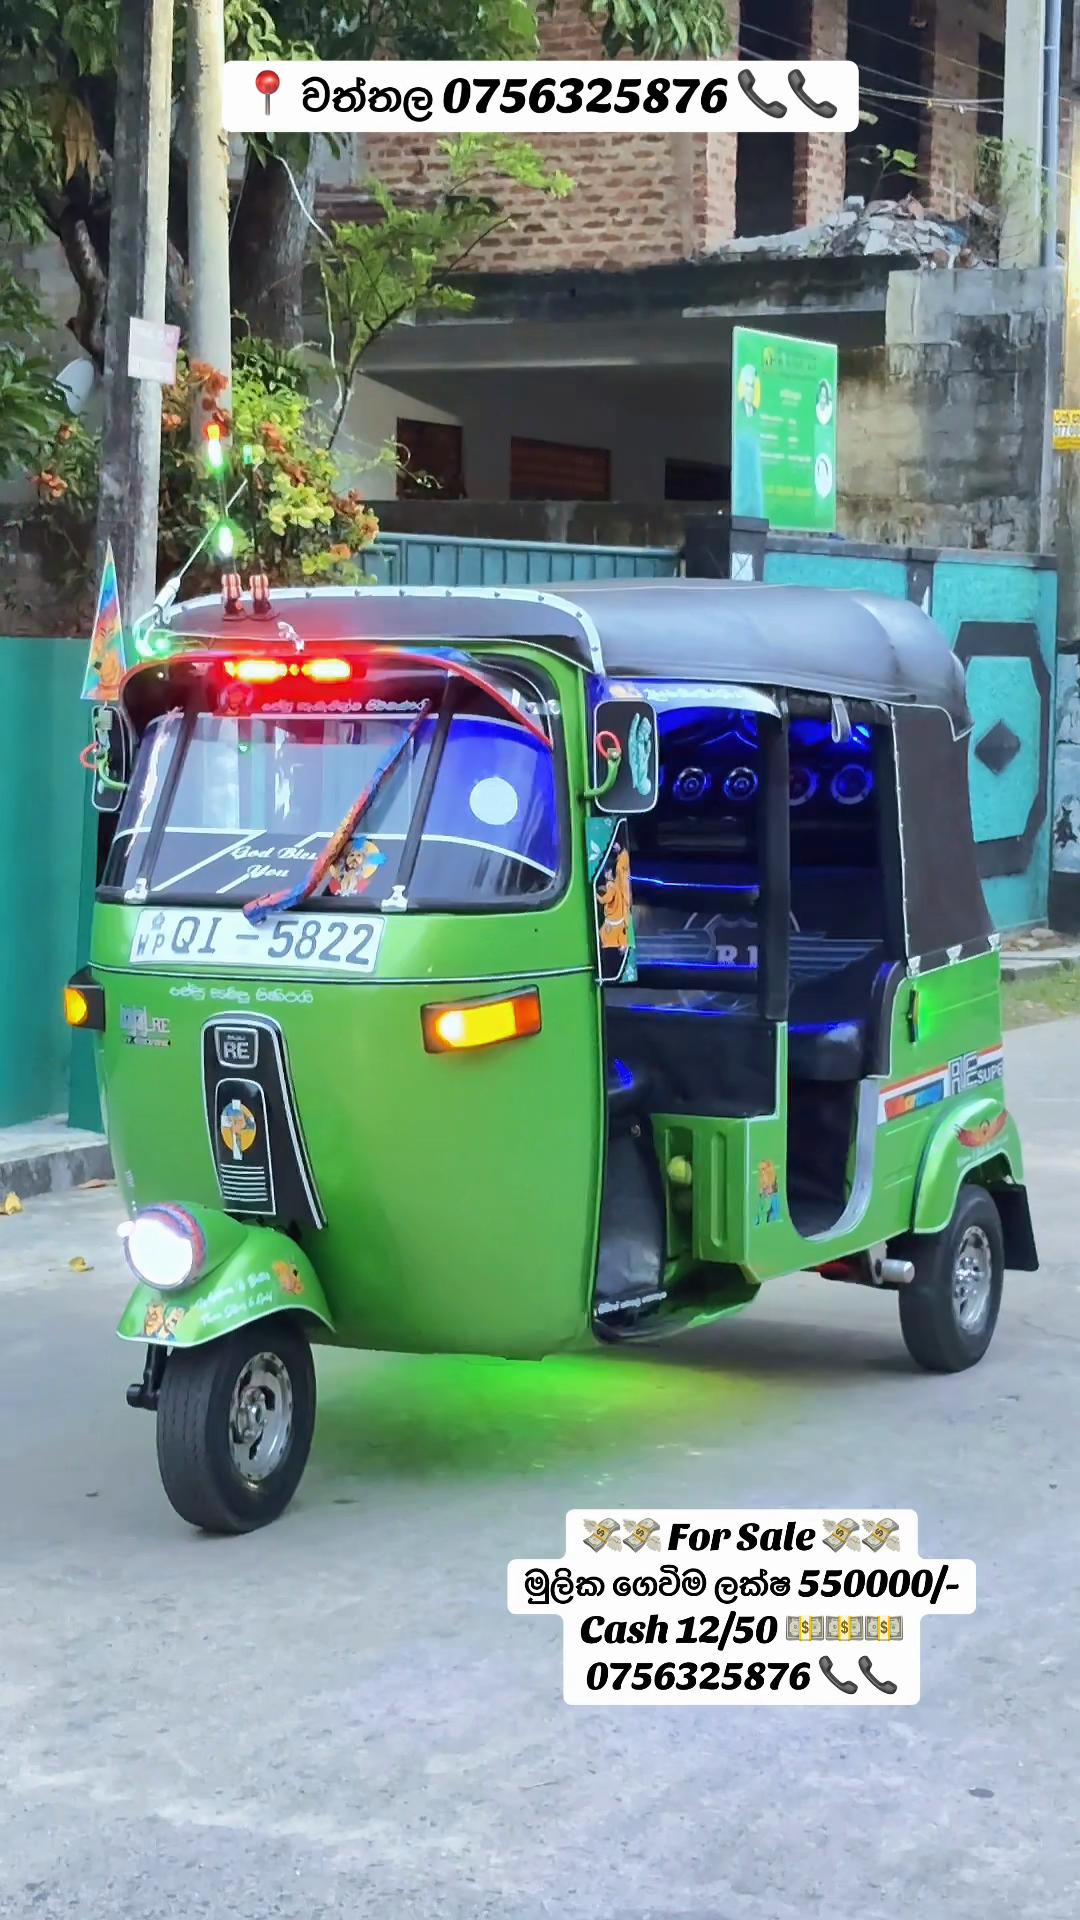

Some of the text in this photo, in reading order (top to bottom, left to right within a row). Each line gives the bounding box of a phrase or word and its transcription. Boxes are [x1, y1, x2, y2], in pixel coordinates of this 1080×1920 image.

[231, 845, 275, 860] God
[246, 863, 290, 879] You
[267, 919, 375, 967] 5822
[223, 1040, 251, 1060] RE
